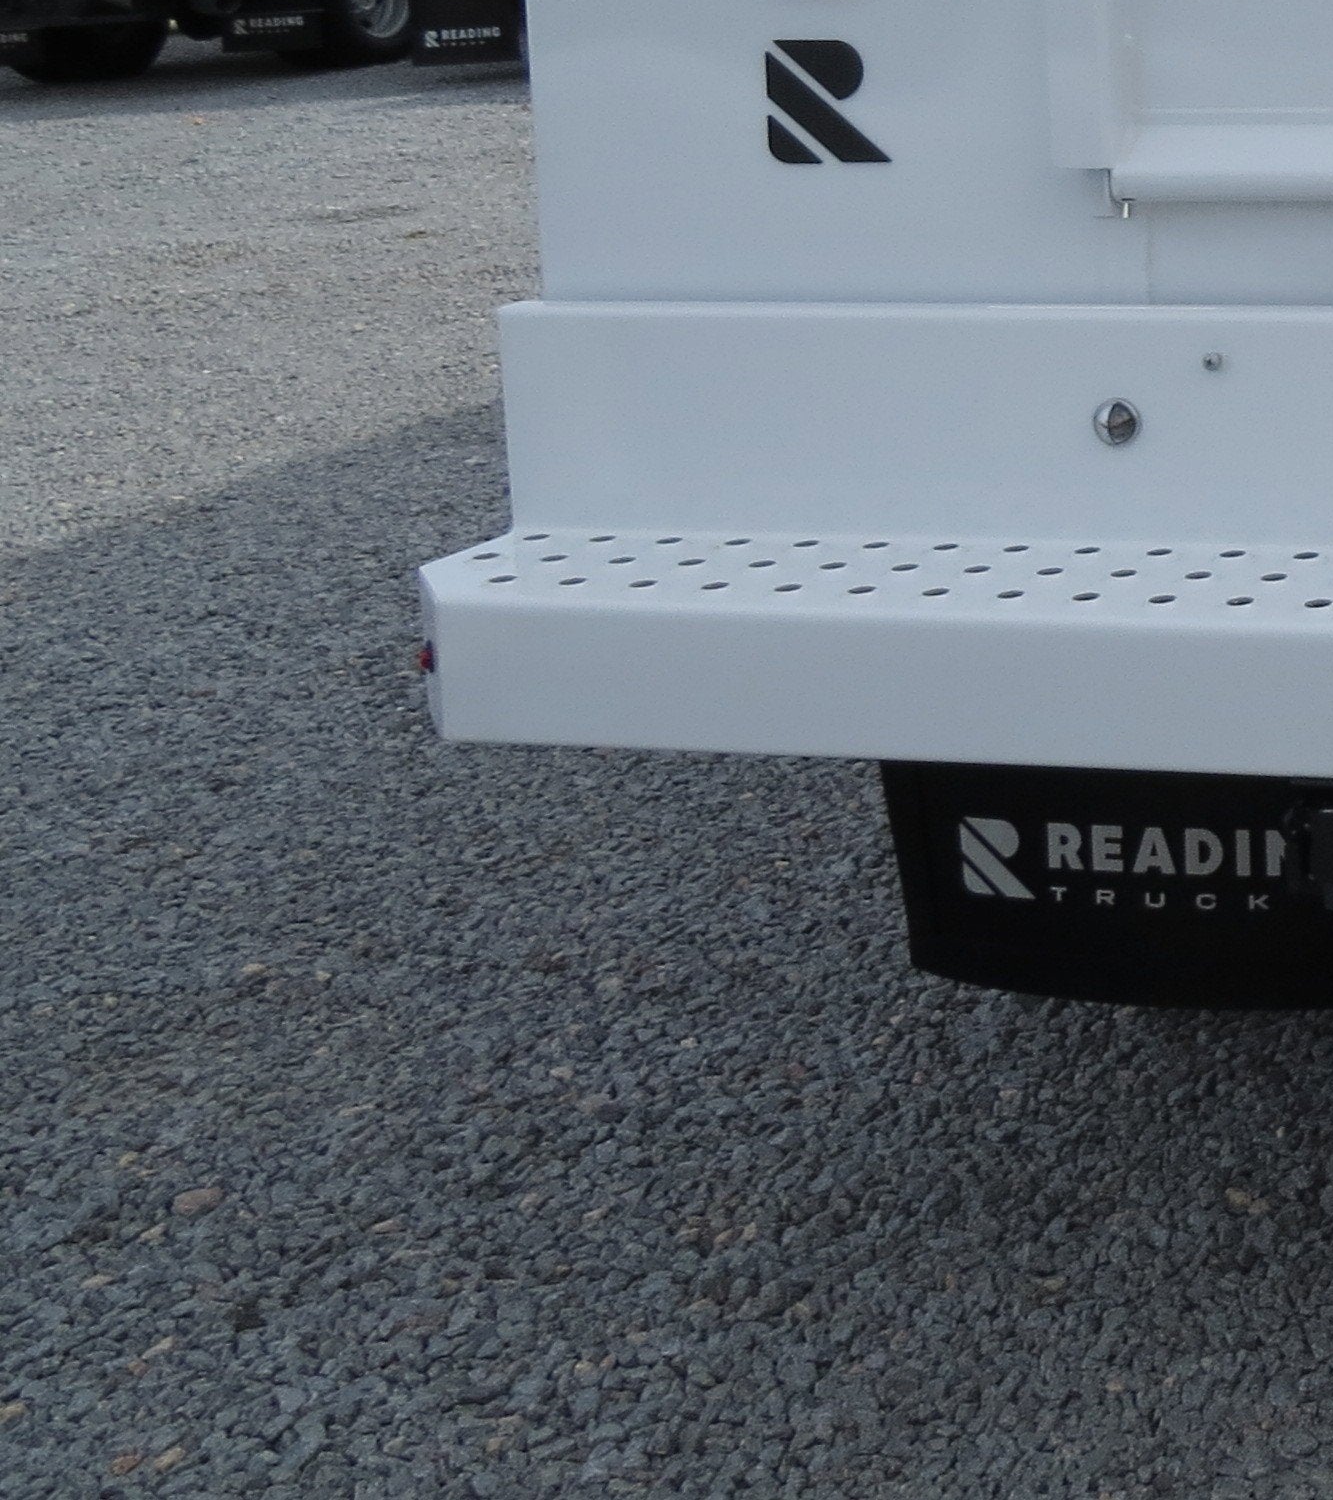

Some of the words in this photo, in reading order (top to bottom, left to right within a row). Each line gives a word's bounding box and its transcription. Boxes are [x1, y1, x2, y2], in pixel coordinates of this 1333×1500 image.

[440, 26, 501, 41] READING
[1046, 822, 1288, 877] READIN
[1049, 885, 1270, 911] TRUCK
